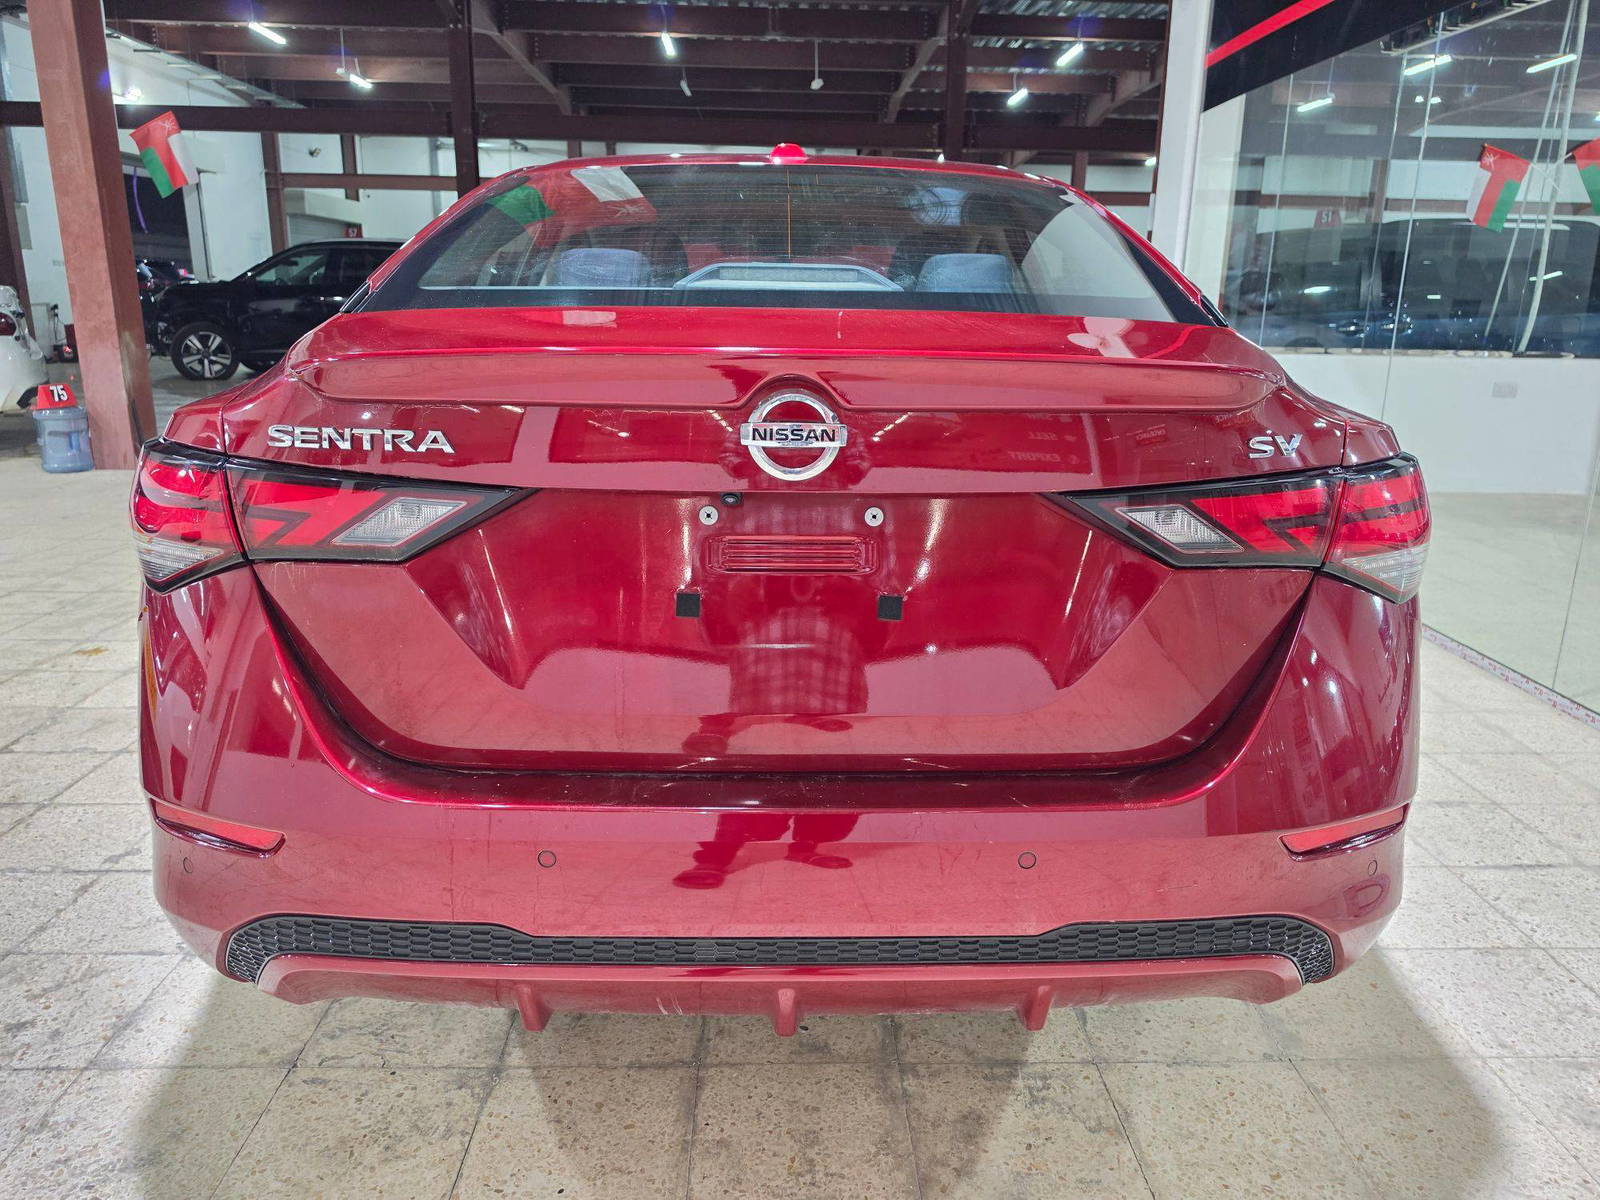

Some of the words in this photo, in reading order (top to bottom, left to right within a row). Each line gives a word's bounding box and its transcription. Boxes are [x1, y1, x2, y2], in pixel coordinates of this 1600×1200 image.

[49, 384, 68, 402] 75
[267, 424, 455, 453] SENTRA
[752, 428, 836, 442] NISSAN
[1248, 433, 1303, 459] SV
